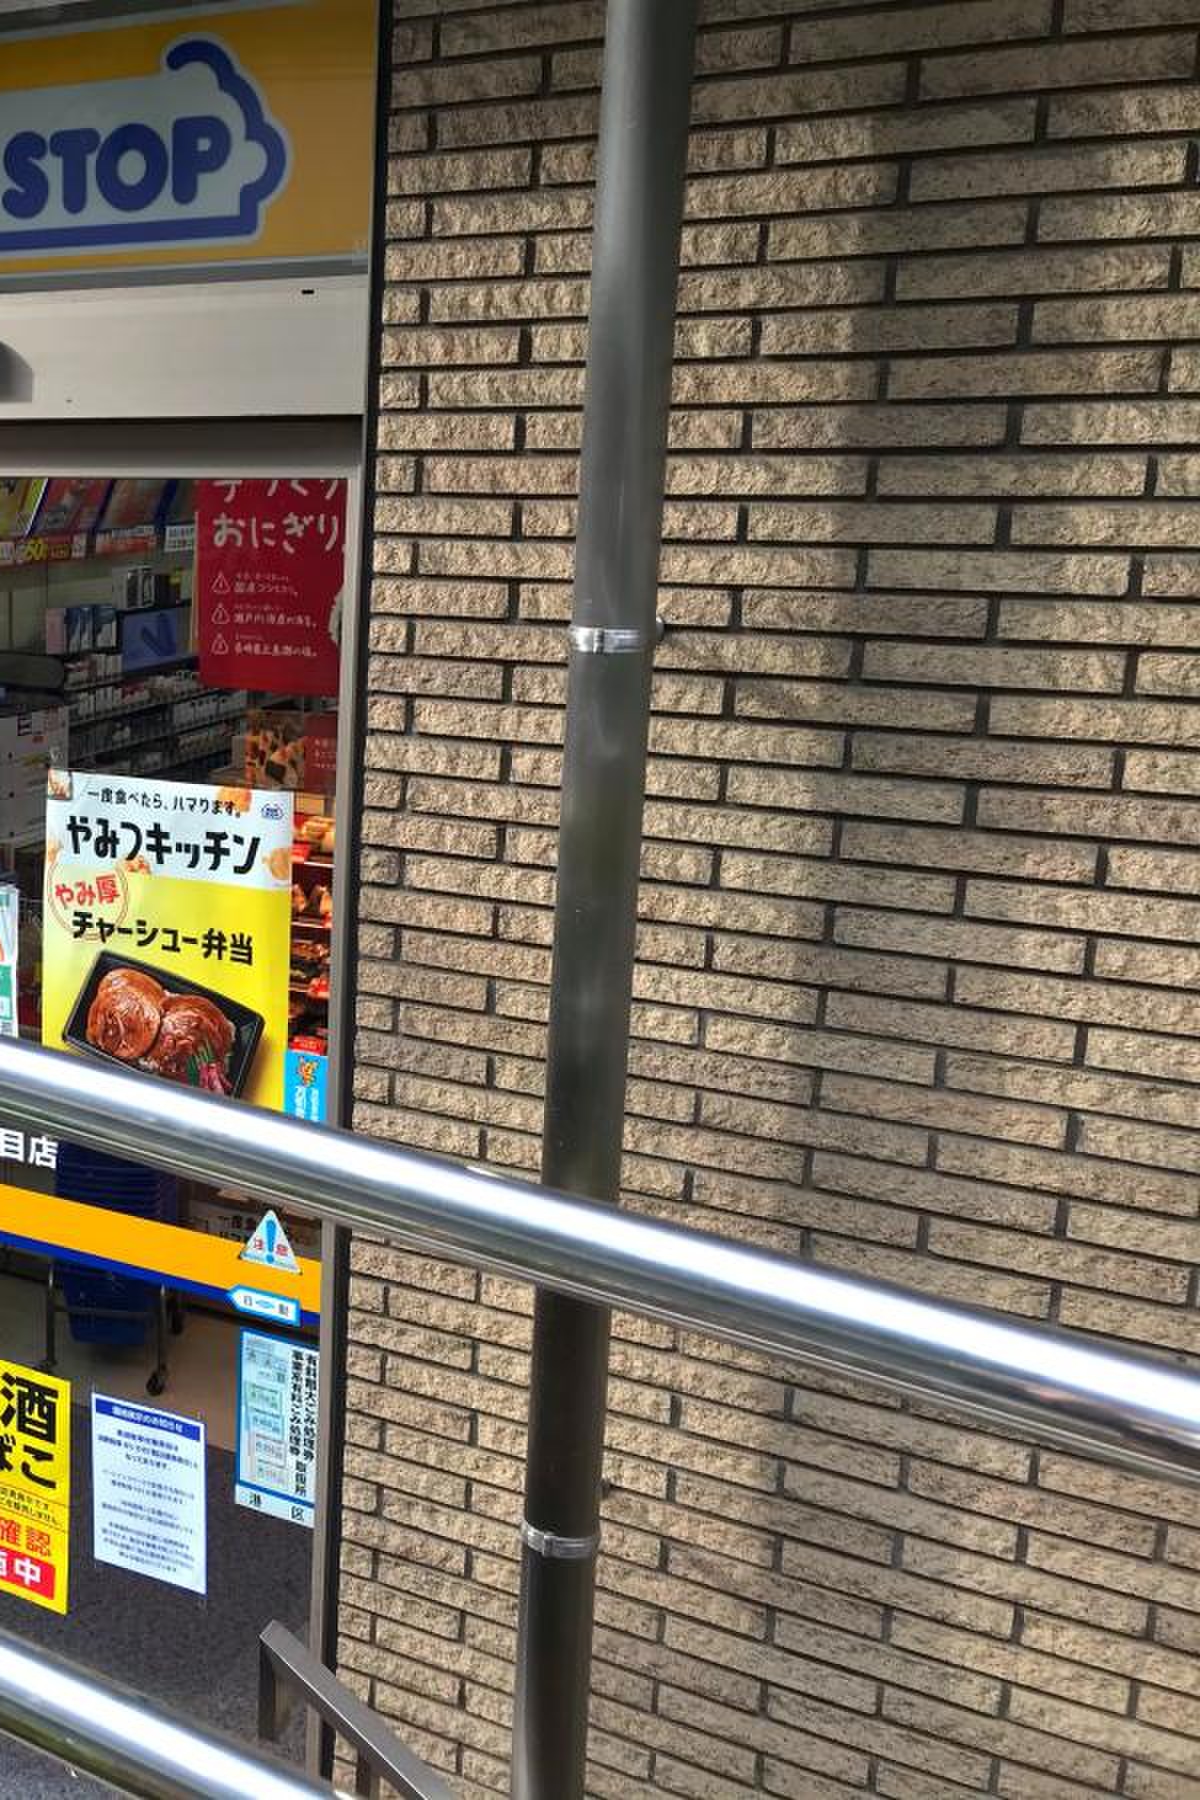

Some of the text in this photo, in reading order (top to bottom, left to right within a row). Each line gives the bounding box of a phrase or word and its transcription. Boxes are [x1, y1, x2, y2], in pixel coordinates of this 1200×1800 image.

[2, 116, 233, 221] STOP
[212, 511, 339, 554] おにぎり
[87, 788, 242, 818] 一度食べたら、ハマります。
[67, 816, 261, 875] やみつキッチン
[54, 873, 120, 907] やみ厚
[71, 911, 254, 966] チャーシュー弁当
